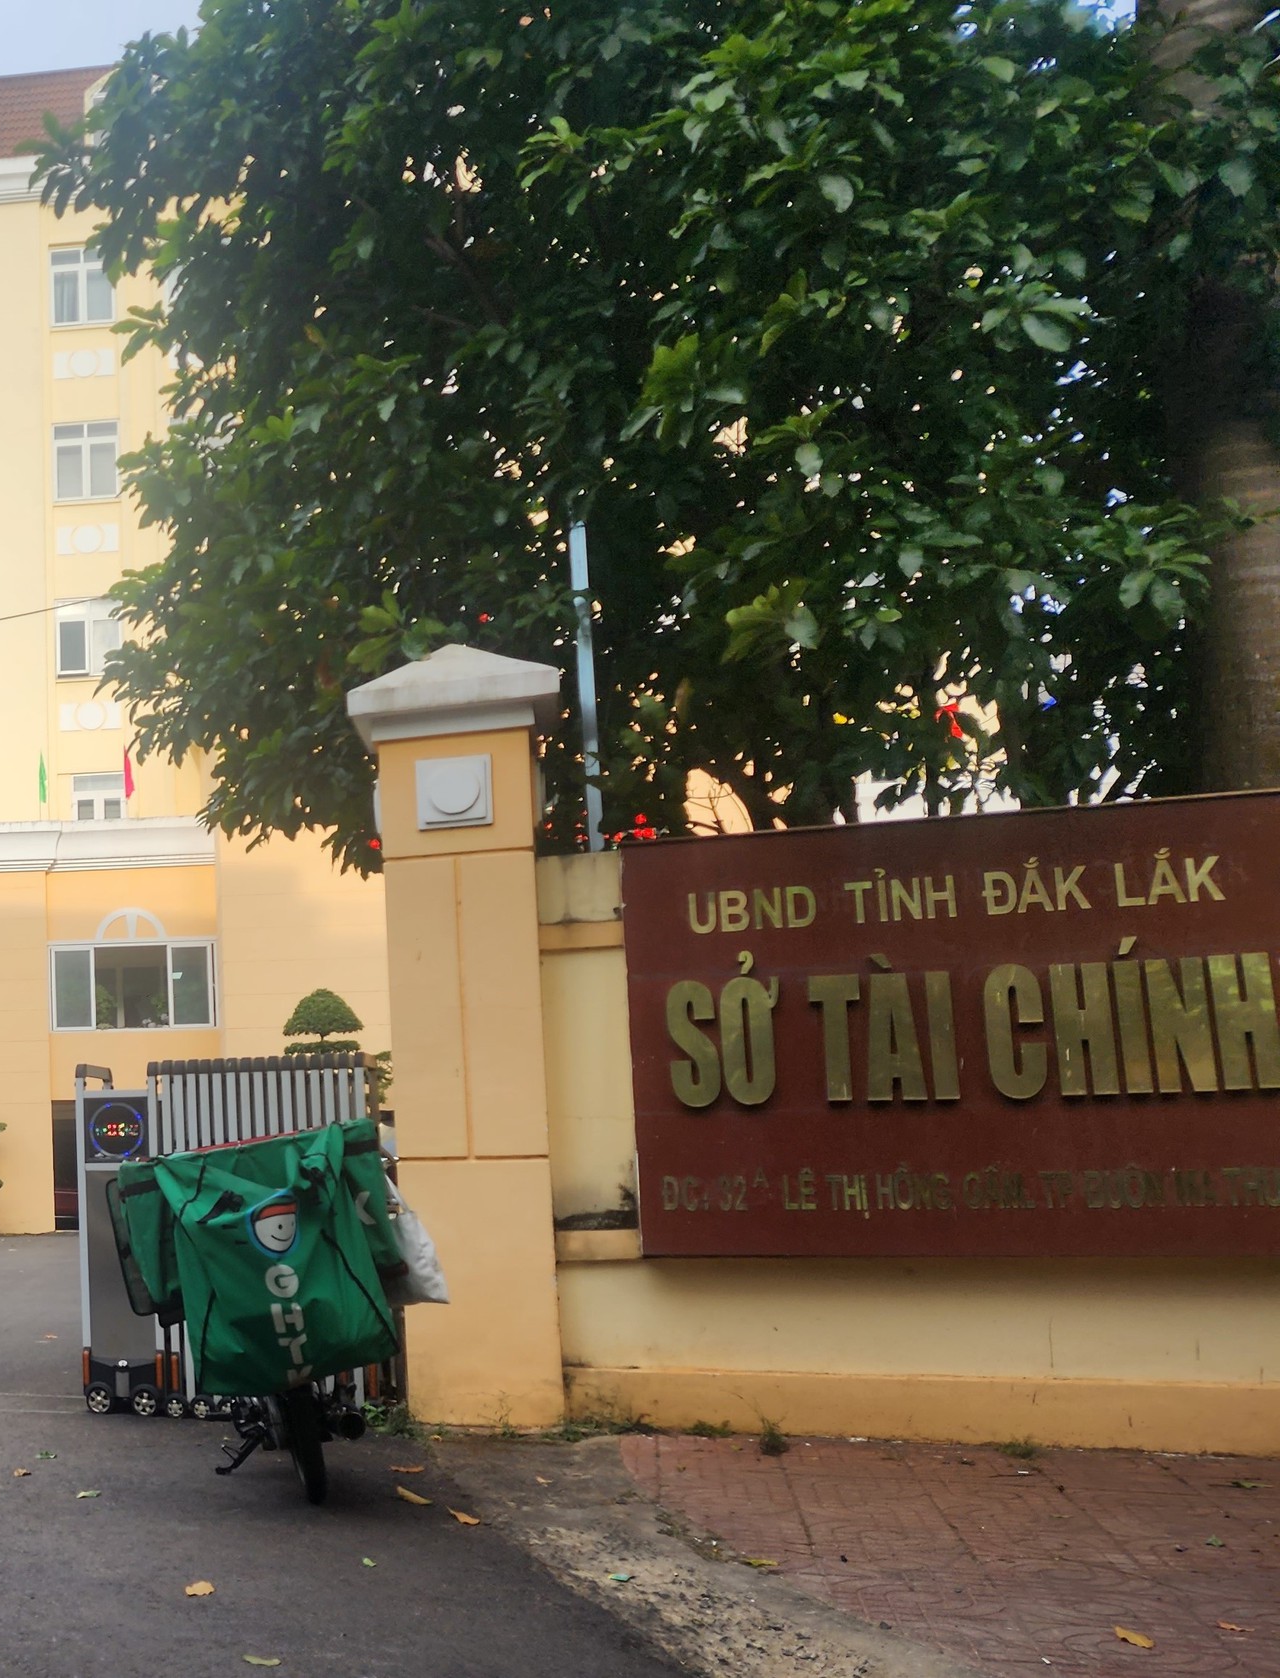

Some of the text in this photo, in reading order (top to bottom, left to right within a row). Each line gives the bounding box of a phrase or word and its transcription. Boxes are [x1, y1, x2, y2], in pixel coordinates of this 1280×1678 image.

[687, 847, 1227, 935] UBND TỈNH ĐẮK LẮK
[665, 935, 1280, 1108] SỞ TÀI CHÍNH
[781, 1166, 818, 1211] LÊ
[824, 1173, 870, 1219] THỊ
